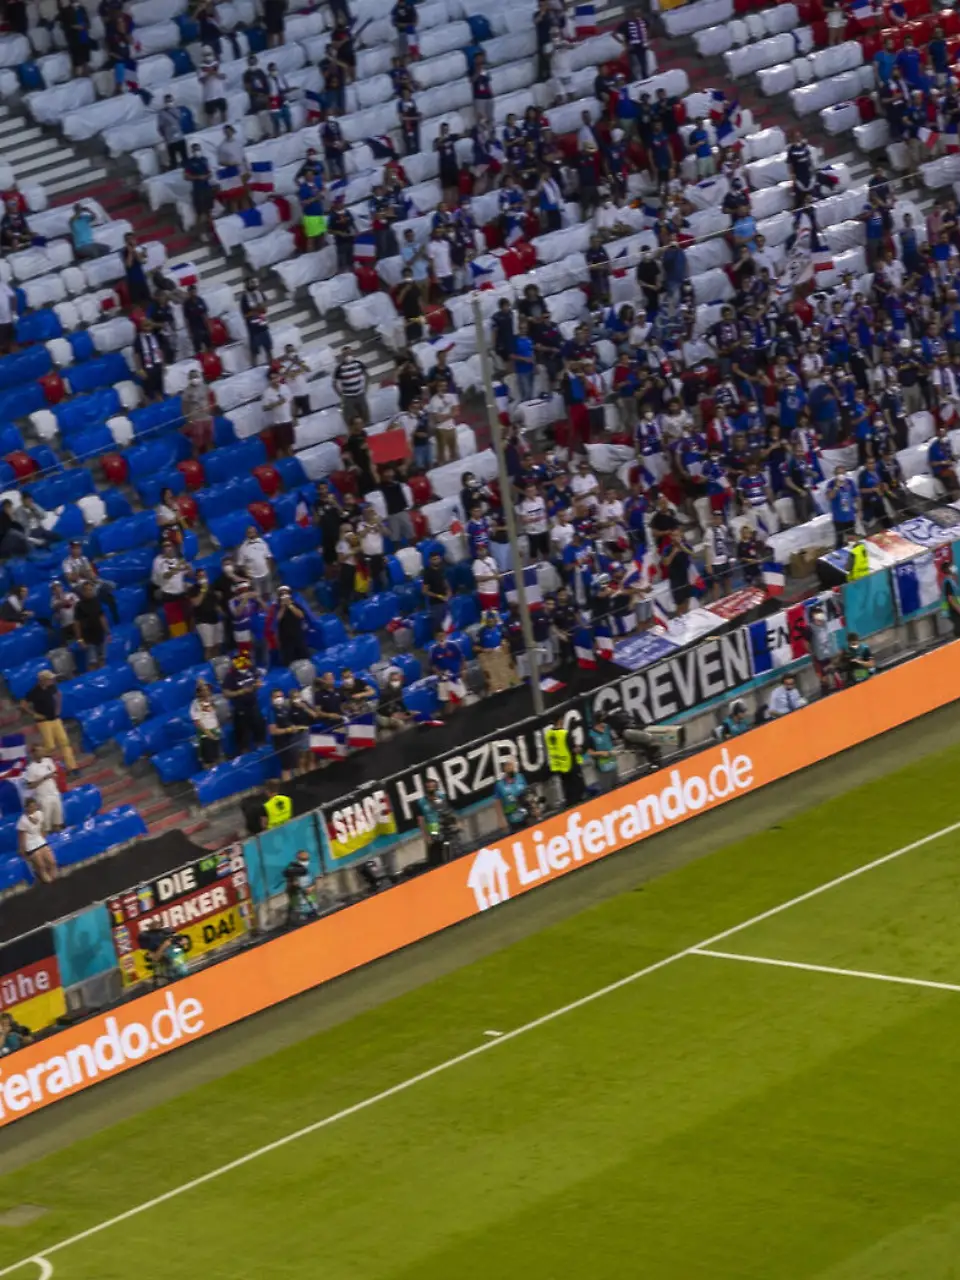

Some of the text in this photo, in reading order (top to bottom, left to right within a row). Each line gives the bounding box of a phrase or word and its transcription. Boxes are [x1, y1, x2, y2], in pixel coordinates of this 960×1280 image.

[331, 790, 392, 845] STADE
[512, 749, 754, 886] Lieferando.de
[157, 867, 197, 900] DIE
[202, 916, 237, 947] DA!
[0, 968, 51, 1005] ühe
